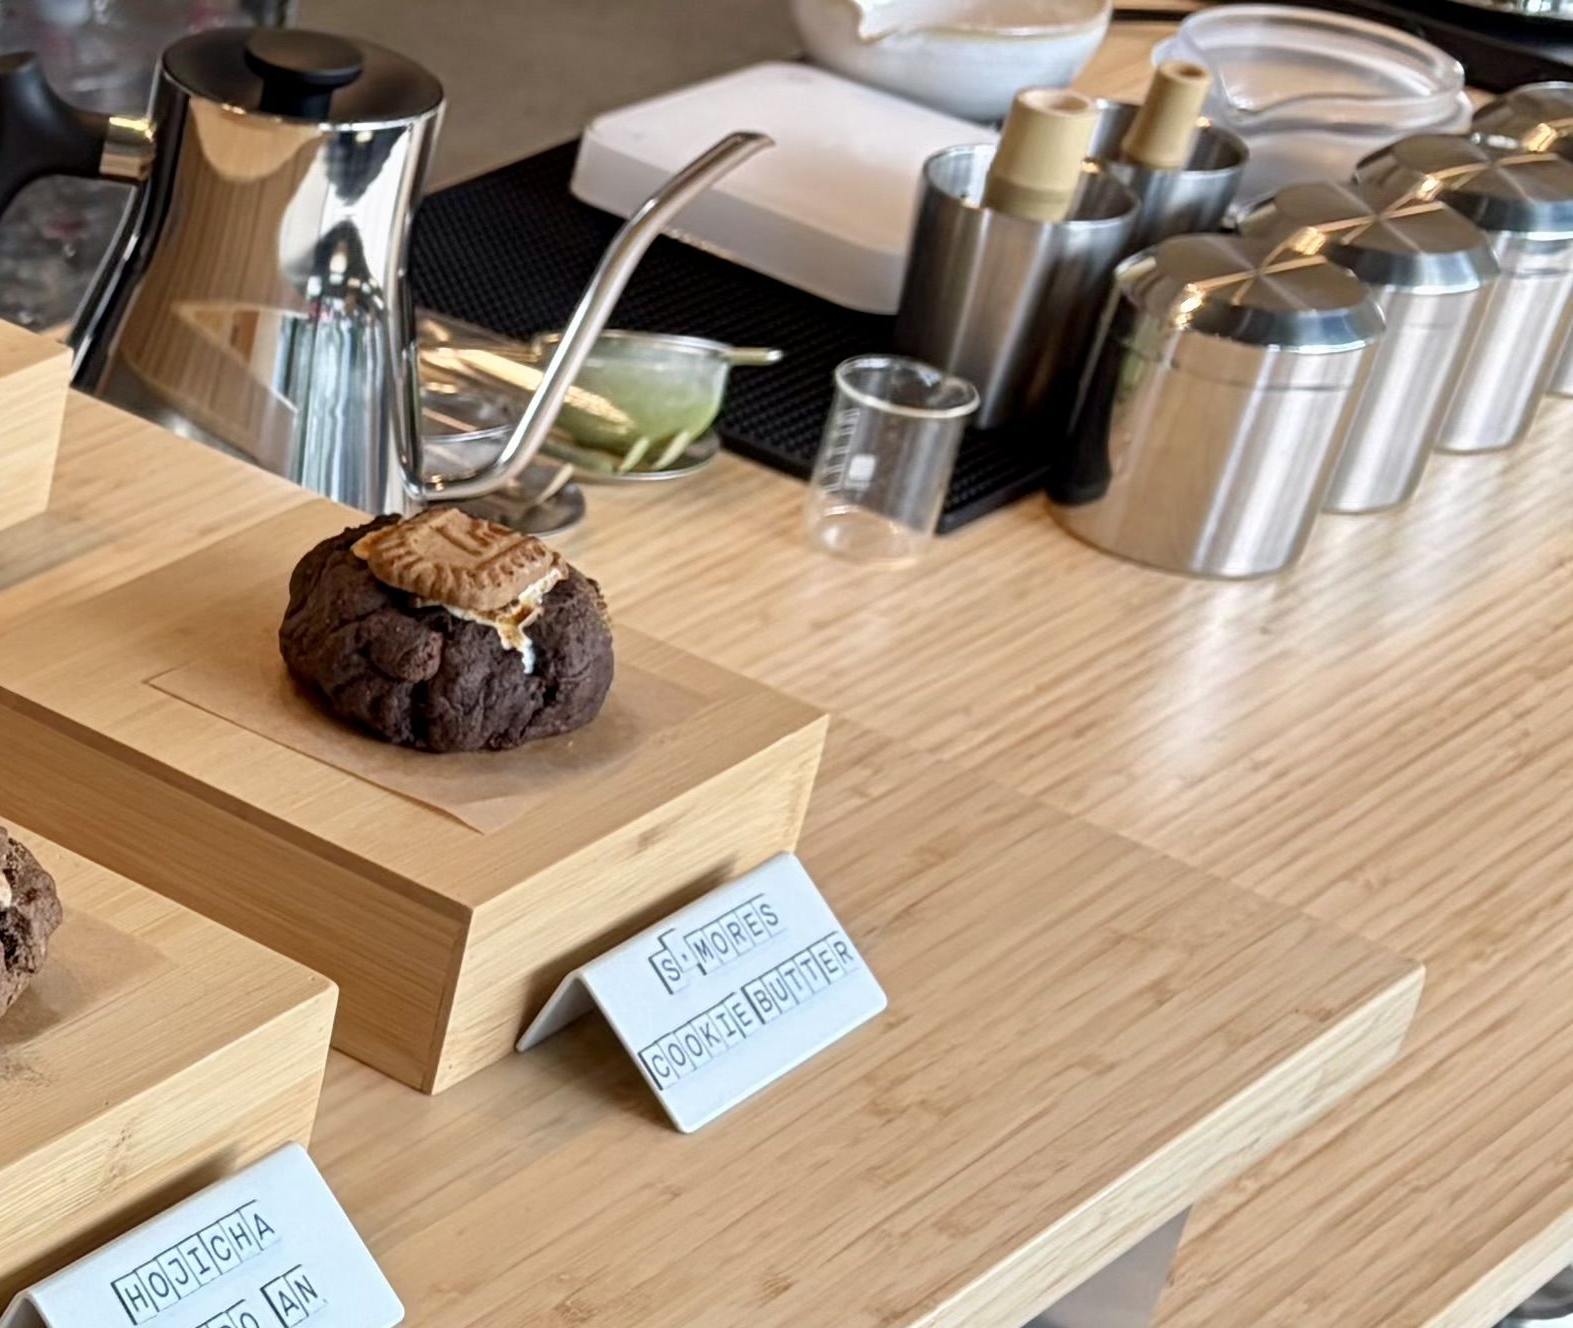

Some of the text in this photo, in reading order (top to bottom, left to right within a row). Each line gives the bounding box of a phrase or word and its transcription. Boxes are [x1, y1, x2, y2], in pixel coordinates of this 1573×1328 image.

[650, 938, 855, 1080] COOKIE BUTTER
[124, 1212, 276, 1315] HOJICHA
[275, 1273, 320, 1319] AN
